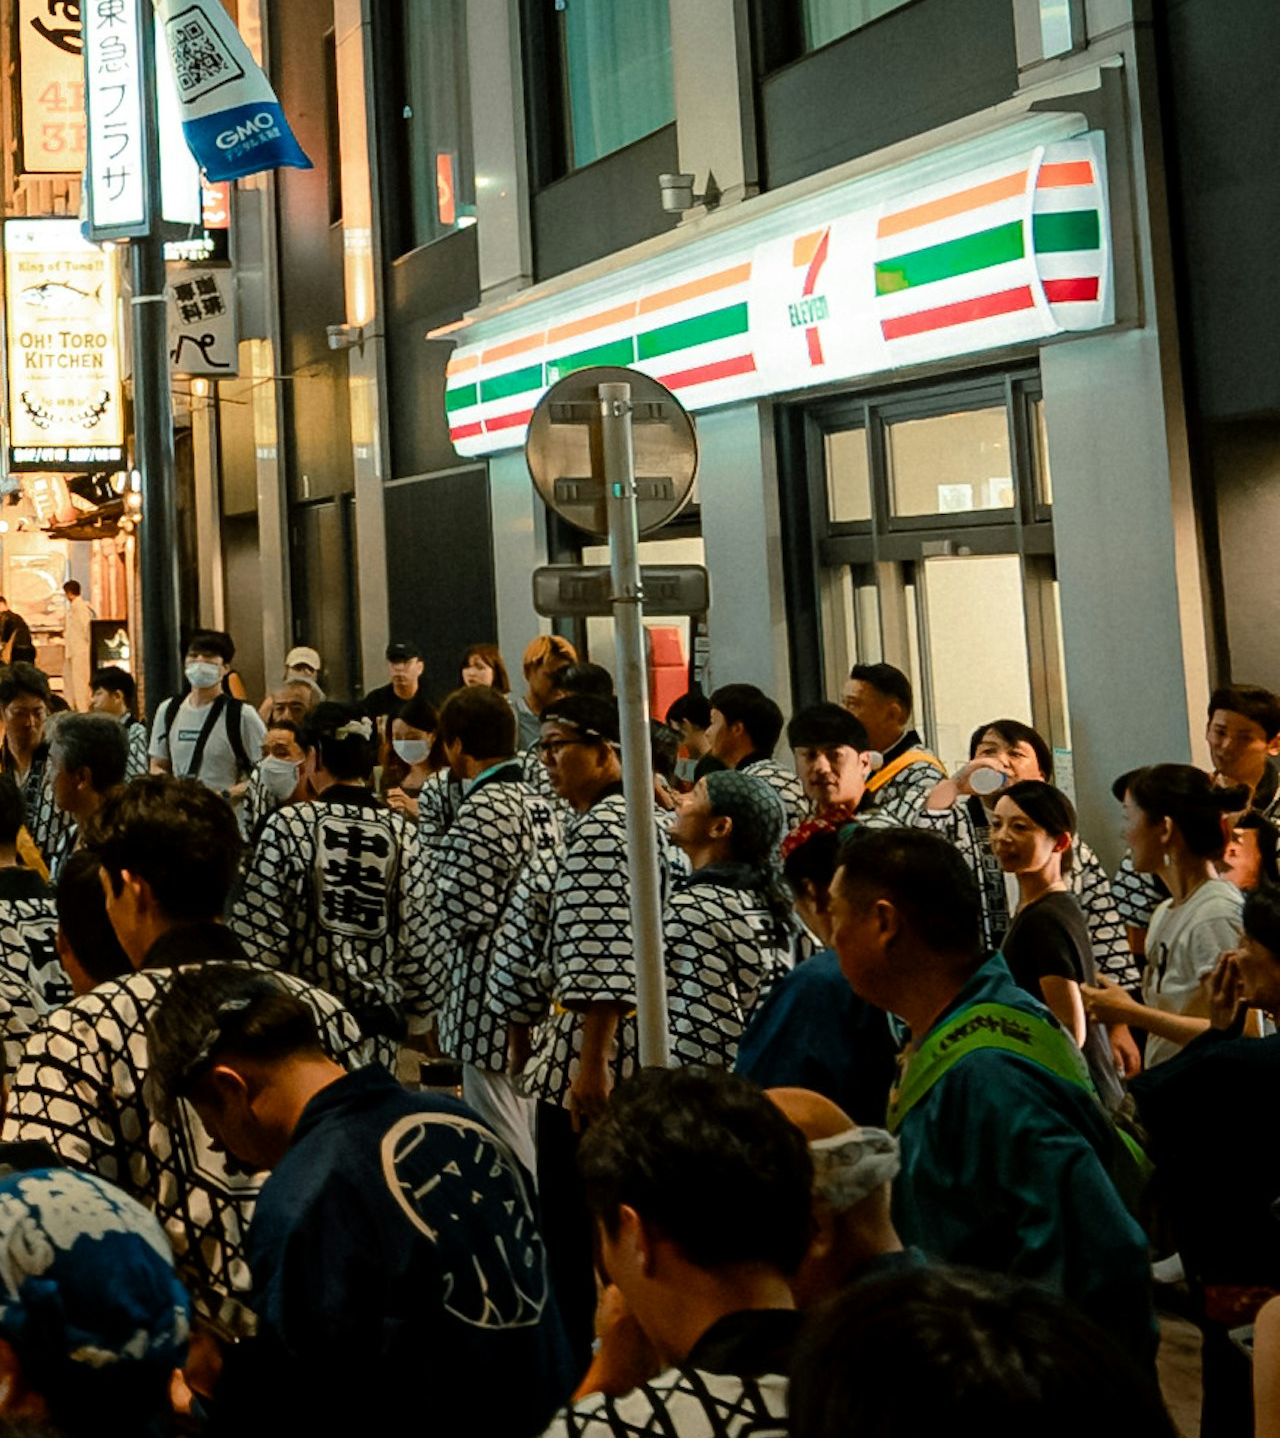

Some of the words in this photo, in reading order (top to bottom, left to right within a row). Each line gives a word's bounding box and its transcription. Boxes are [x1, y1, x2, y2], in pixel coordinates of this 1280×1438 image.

[215, 111, 275, 150] GMO
[792, 224, 831, 367] 7
[321, 824, 390, 932] 中央街
